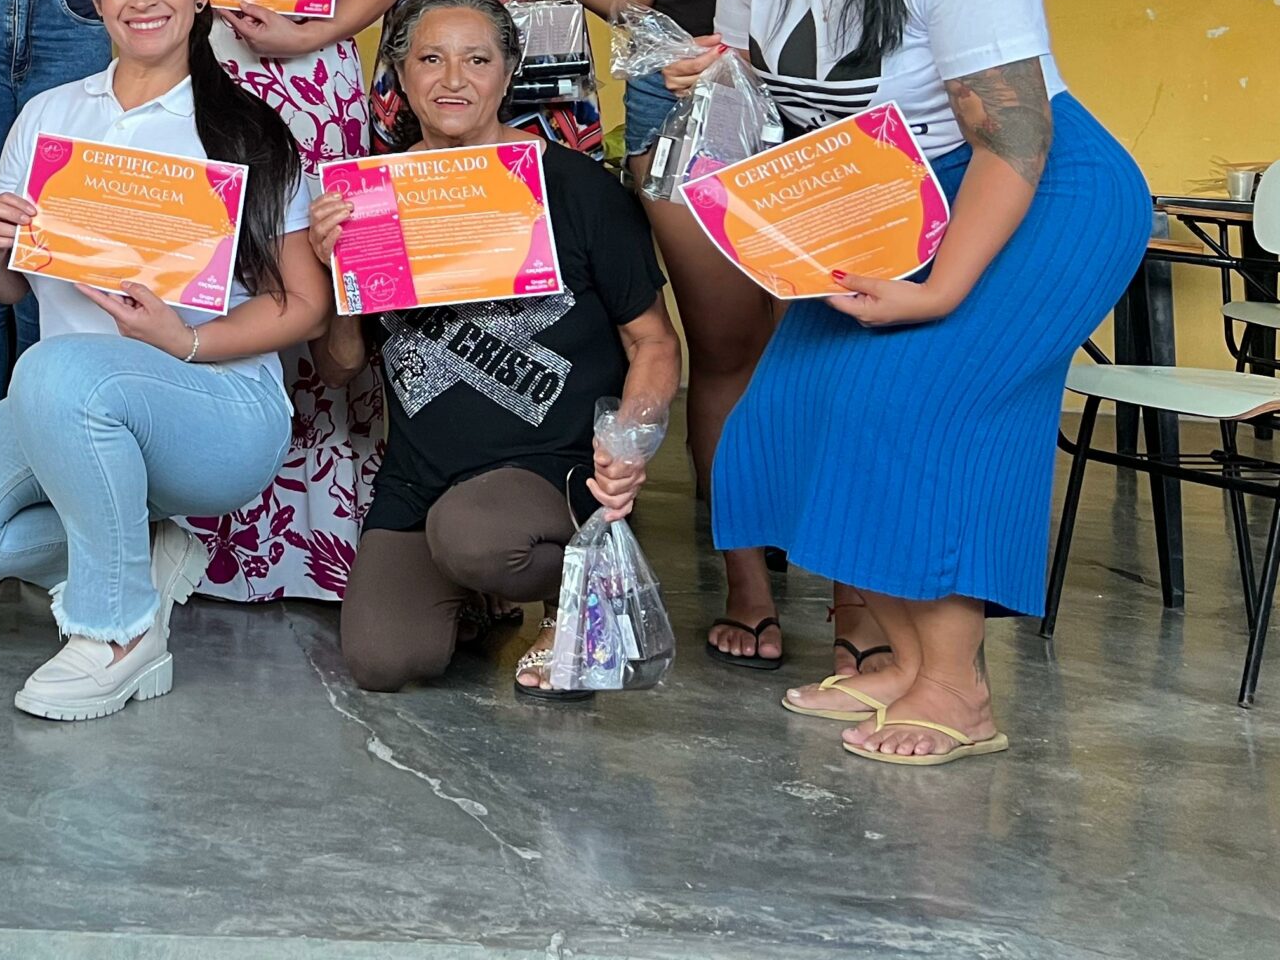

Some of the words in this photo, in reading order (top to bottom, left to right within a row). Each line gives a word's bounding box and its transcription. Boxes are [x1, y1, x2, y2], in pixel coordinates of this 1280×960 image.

[82, 149, 195, 180] CERTIFICADO
[388, 155, 488, 178] RTIFICADO
[734, 131, 852, 188] CERTIFICADO
[84, 174, 185, 205] MAQUIAGEM
[397, 184, 488, 207] AQUIAGEM
[752, 162, 862, 210] MAQUIAGEM
[446, 321, 561, 405] CRISTO
